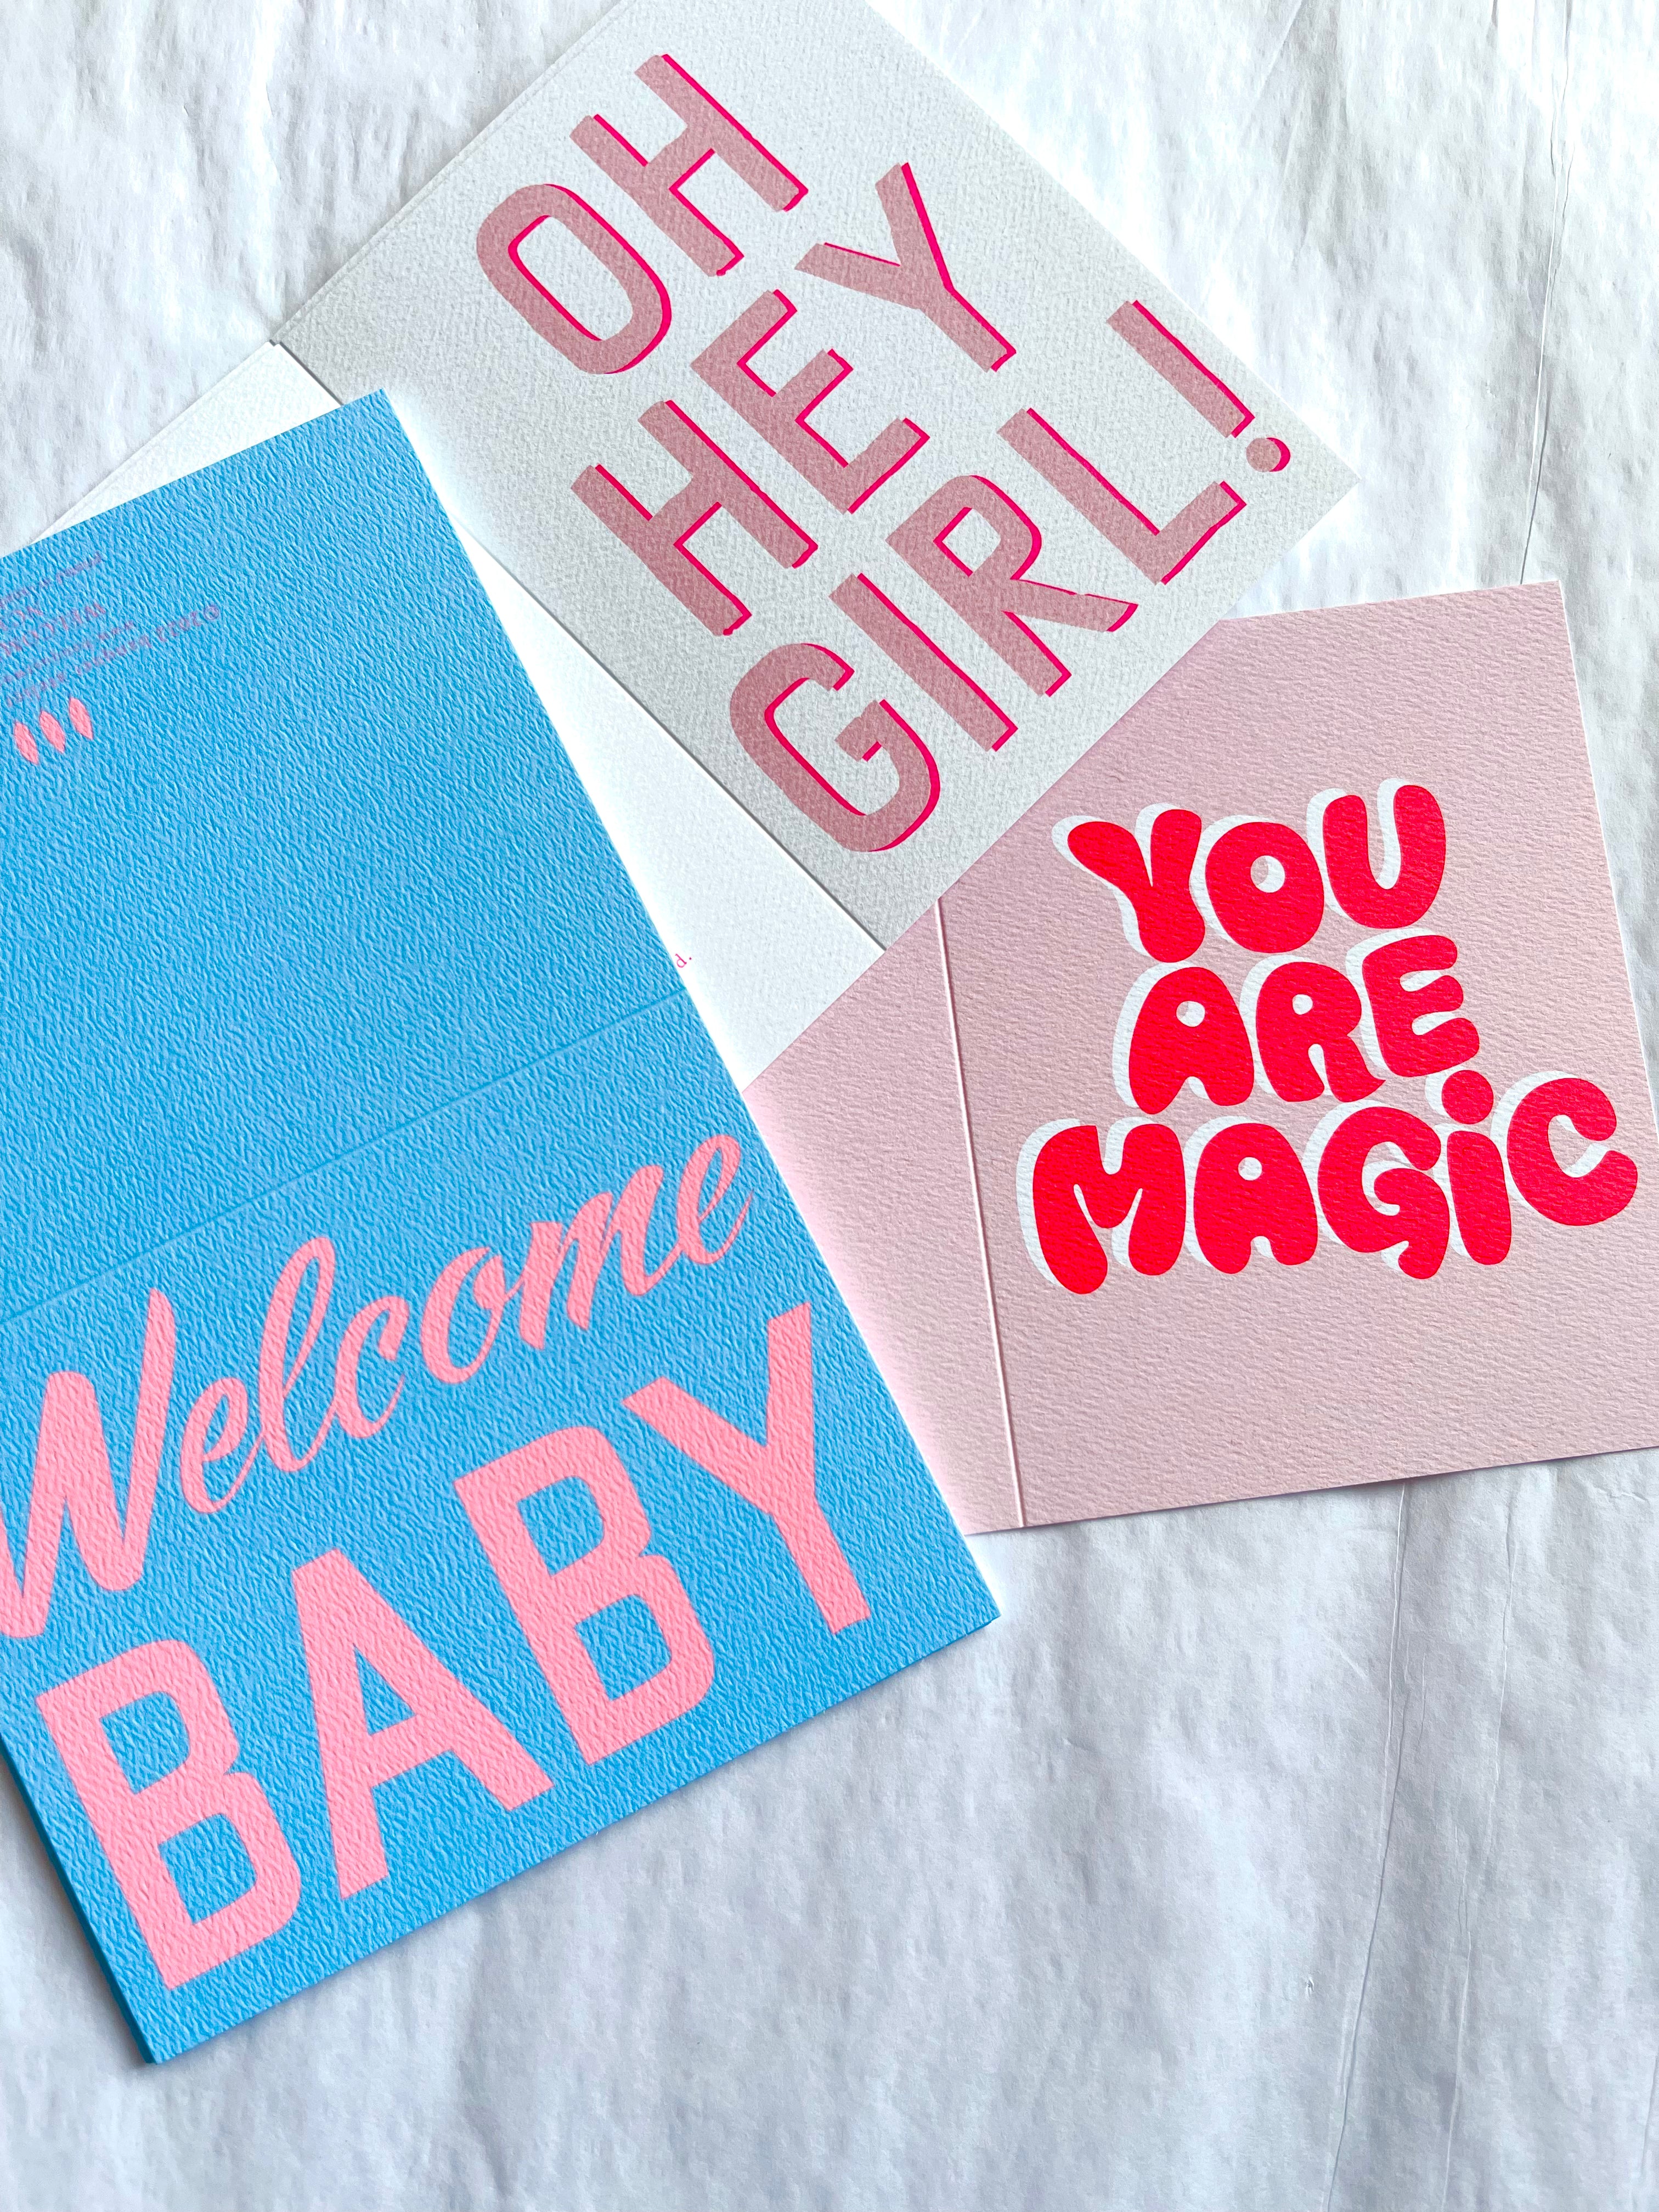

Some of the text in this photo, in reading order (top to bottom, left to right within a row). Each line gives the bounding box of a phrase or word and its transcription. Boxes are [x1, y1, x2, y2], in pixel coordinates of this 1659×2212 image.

[476, 53, 809, 375] OH
[570, 162, 1017, 636] HEY
[730, 299, 1291, 853] GIRL!
[1051, 777, 1447, 963] YOU
[1112, 927, 1480, 1115] ARE
[0, 1134, 755, 1639] Welcome
[35, 1301, 871, 1990] BABY
